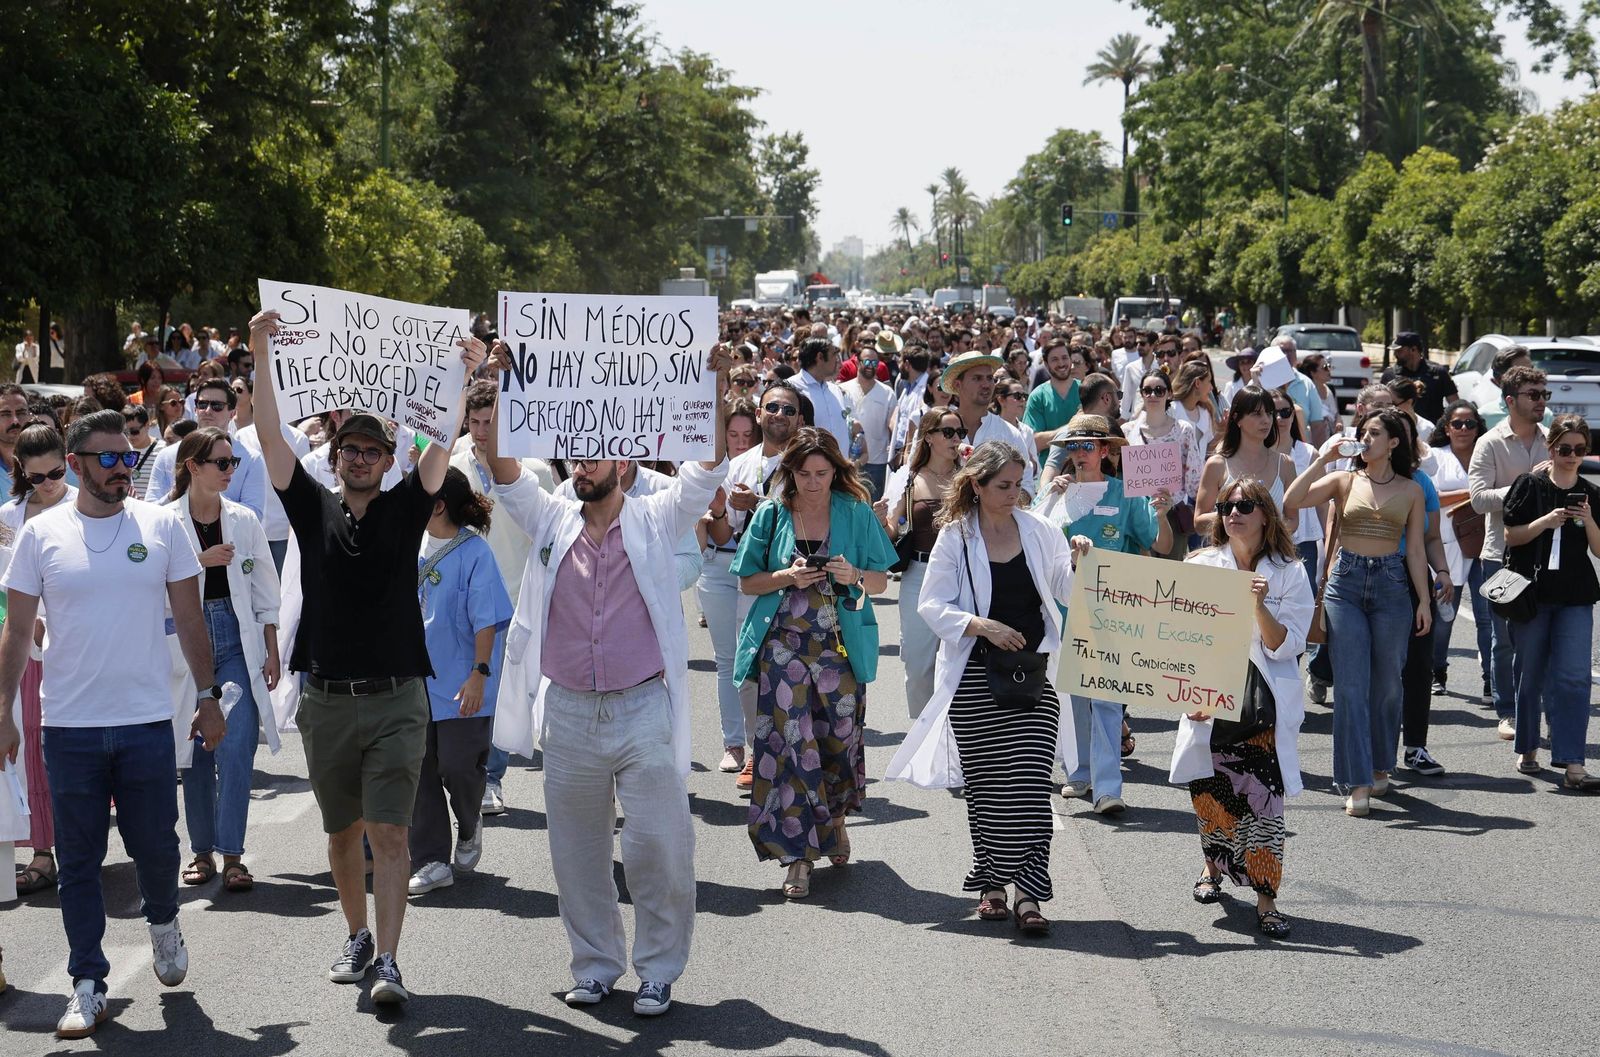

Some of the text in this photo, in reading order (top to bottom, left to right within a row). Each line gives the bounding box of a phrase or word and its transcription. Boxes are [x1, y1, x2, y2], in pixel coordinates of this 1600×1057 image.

[345, 302, 379, 330] NO
[330, 330, 366, 356] NO
[548, 350, 585, 388] HAY
[591, 351, 660, 391] SALUD,
[289, 385, 398, 418] TRABAJO!
[424, 375, 447, 412] EL
[509, 399, 598, 436] DERECHOS
[632, 396, 664, 433] HAY
[672, 413, 682, 421] UN
[1136, 461, 1177, 474] NO NOS
[1080, 673, 1236, 711] LABORALES JUSTAS
